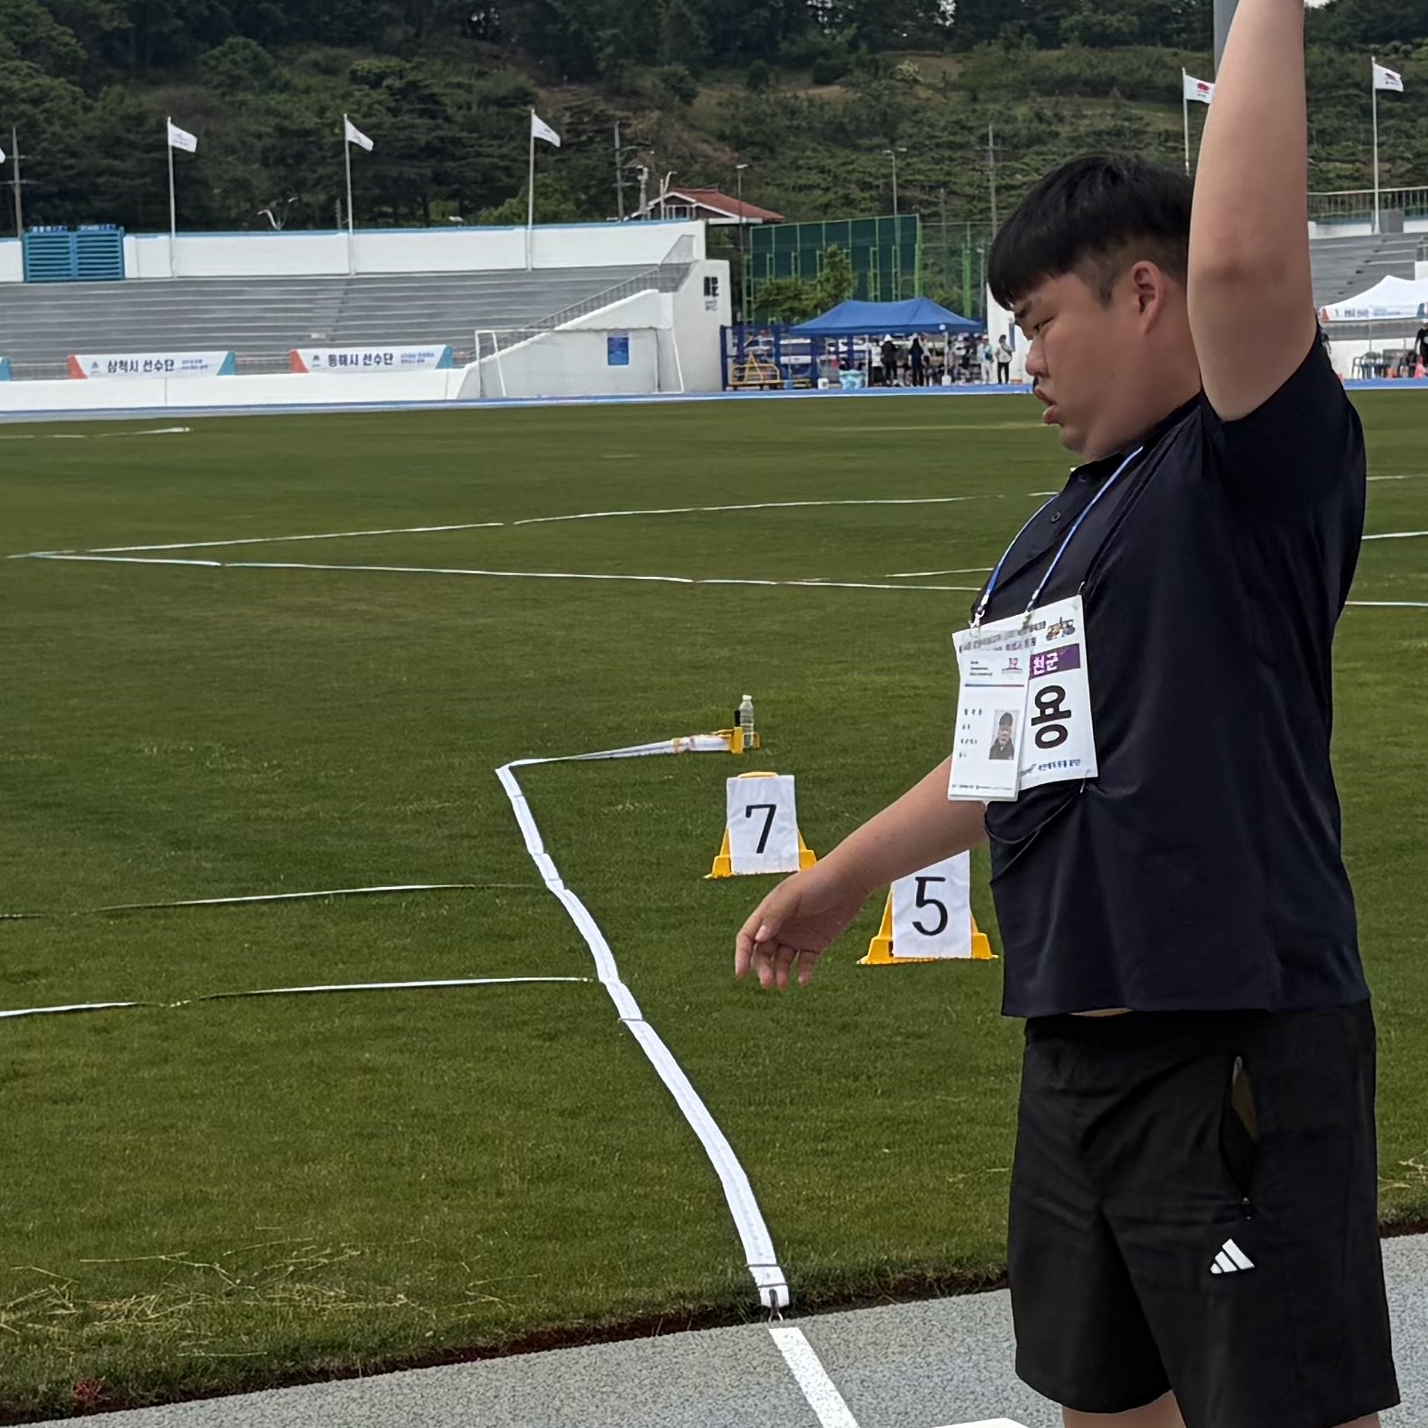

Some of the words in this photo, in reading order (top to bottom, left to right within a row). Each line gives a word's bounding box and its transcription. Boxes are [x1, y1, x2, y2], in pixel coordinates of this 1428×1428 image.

[107, 360, 139, 373] 삼척시
[143, 359, 174, 373] 선수단
[363, 352, 393, 366] 선수단
[1031, 685, 1071, 749] 용
[744, 803, 777, 854] 7
[912, 876, 948, 936] 5
